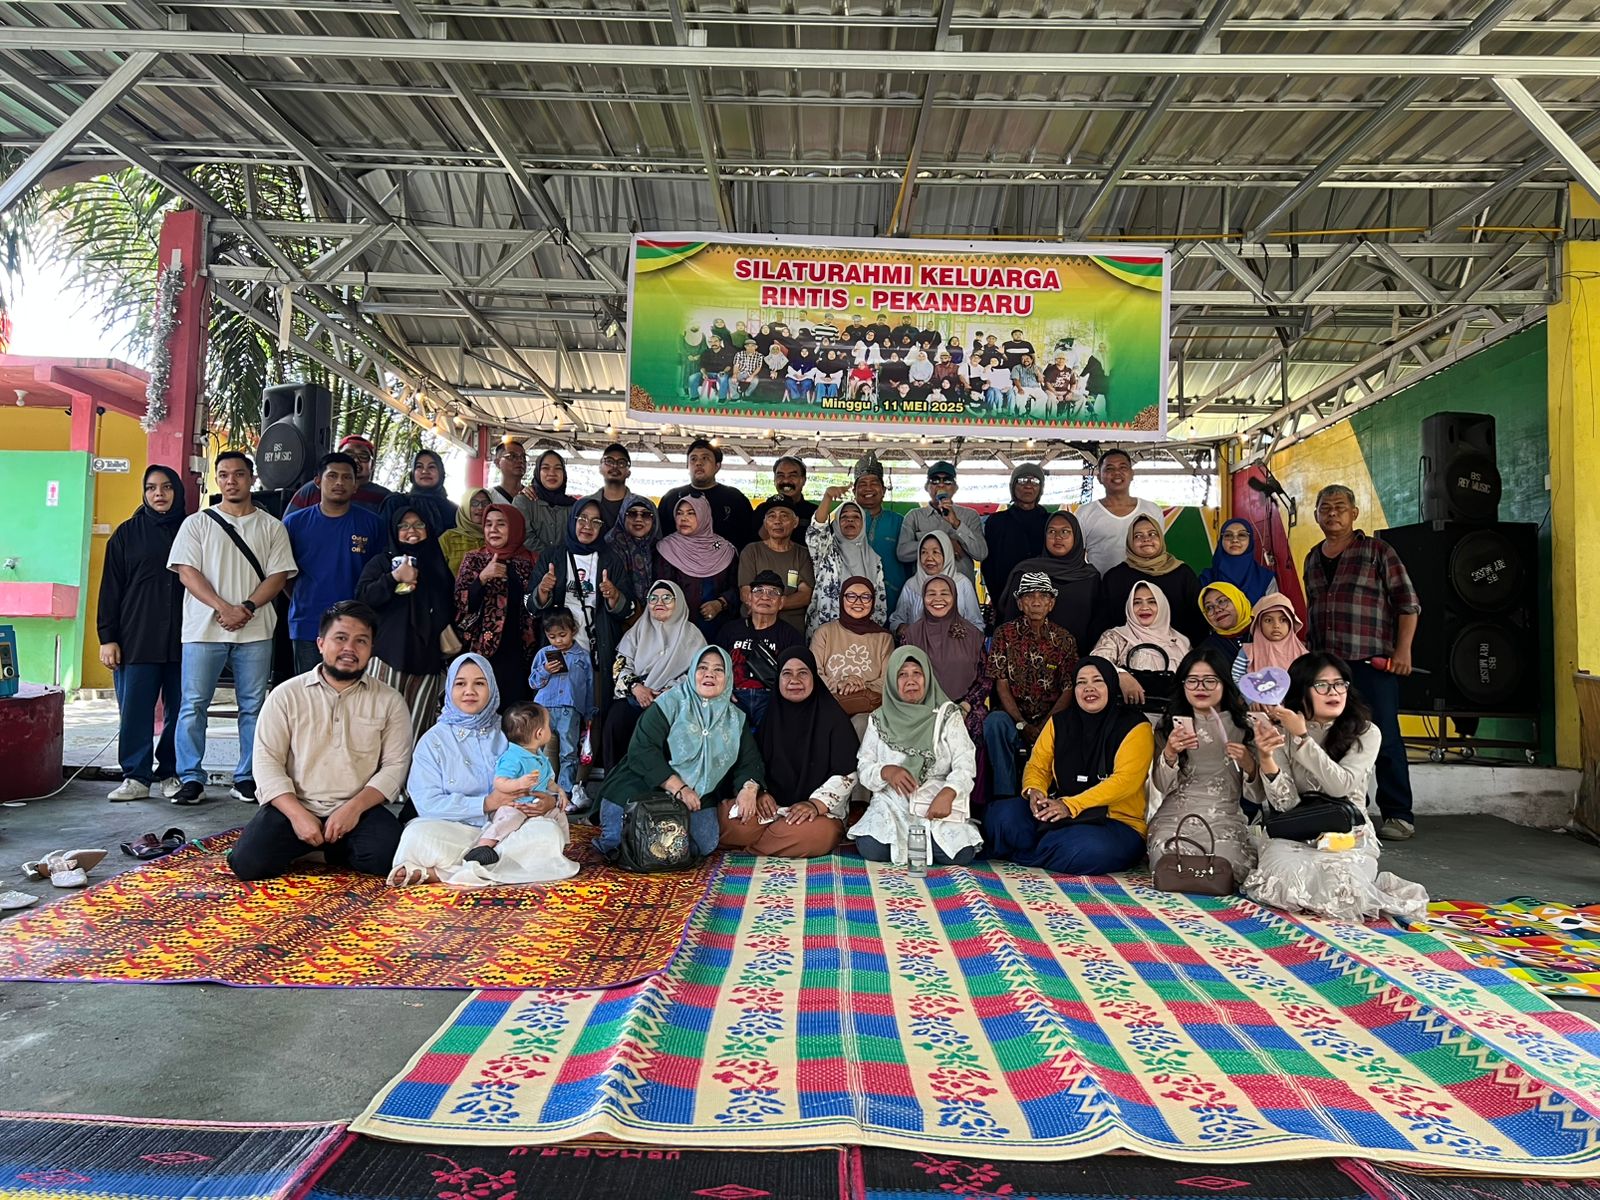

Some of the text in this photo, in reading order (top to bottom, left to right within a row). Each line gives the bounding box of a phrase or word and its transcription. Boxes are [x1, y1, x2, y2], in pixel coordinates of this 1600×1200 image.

[735, 259, 1060, 289] SILATURAHMI KELUARGA
[761, 286, 848, 309] RINTIS
[872, 290, 1032, 315] PEKANBARU
[821, 397, 871, 411] Minggu
[883, 400, 898, 411] 11
[902, 401, 928, 412] MEI
[931, 402, 965, 413] 2025
